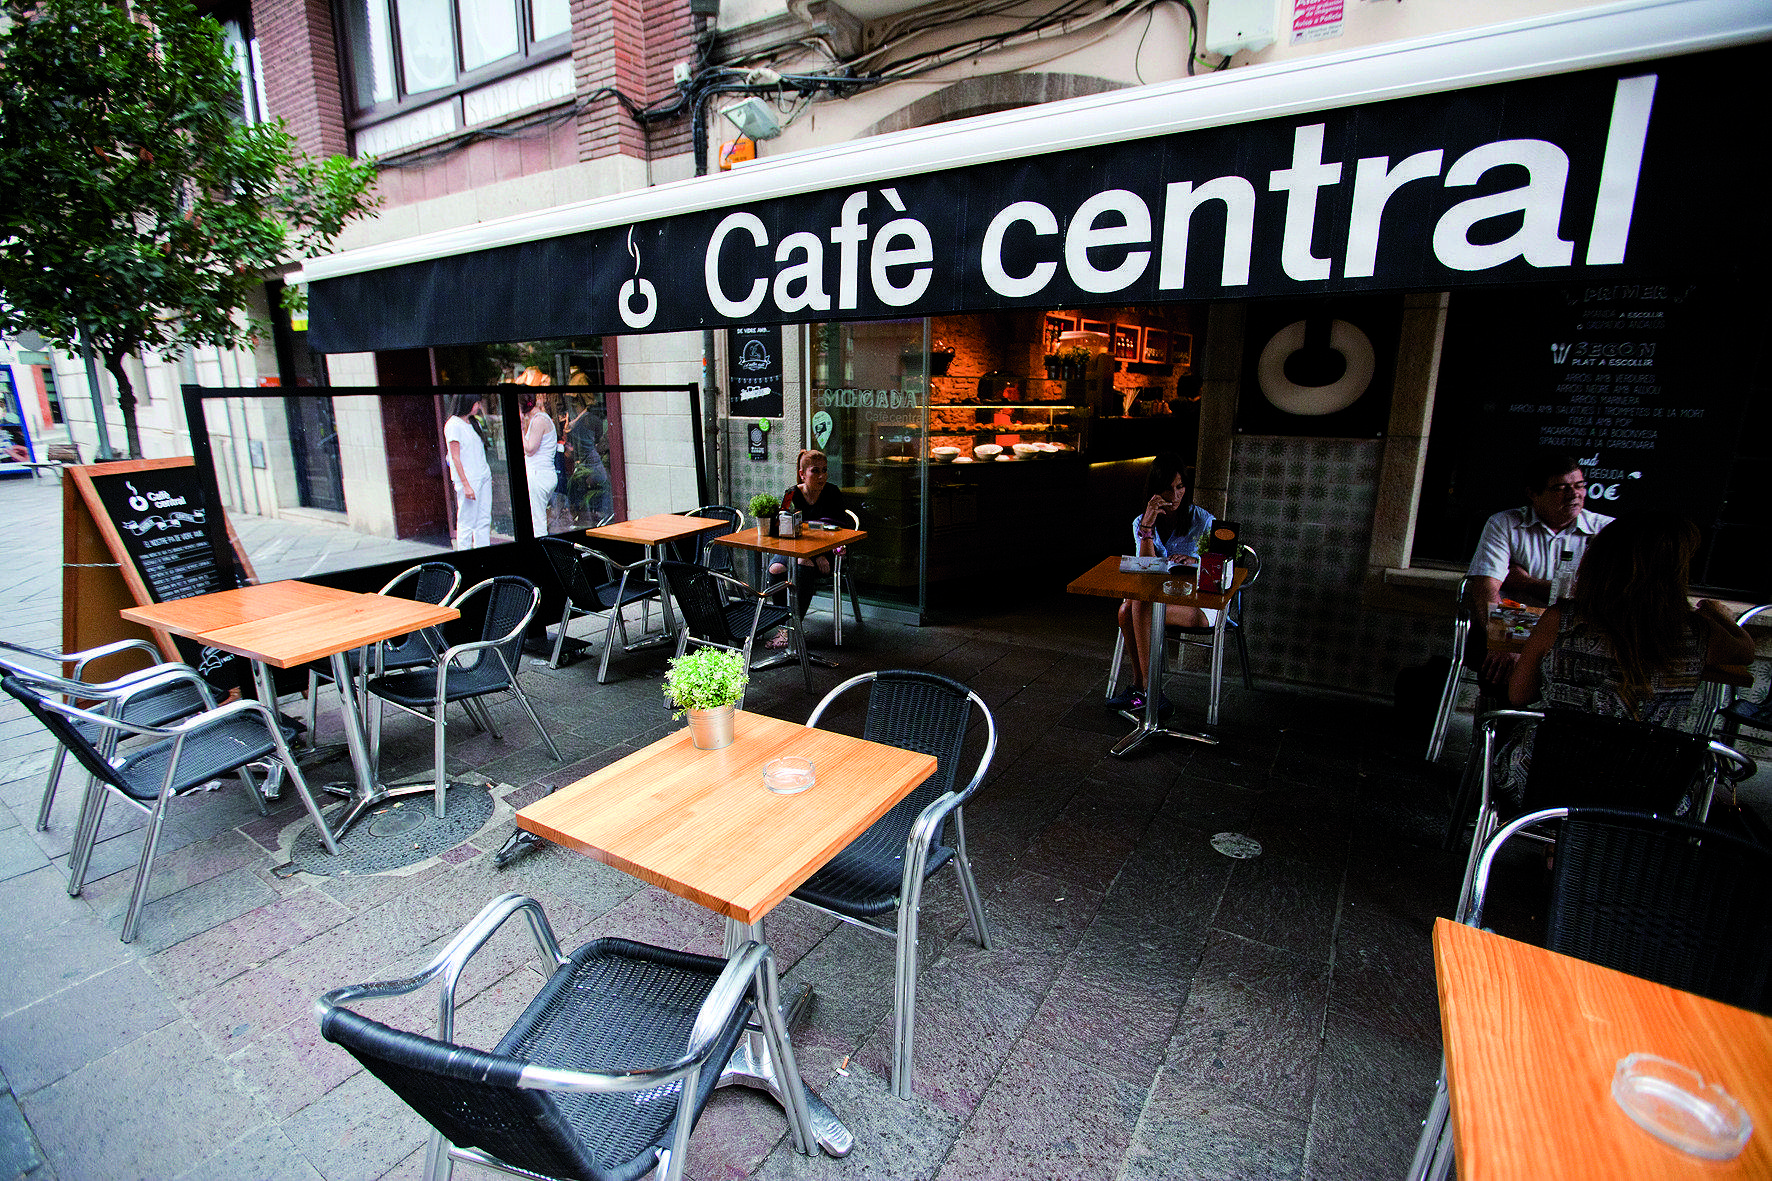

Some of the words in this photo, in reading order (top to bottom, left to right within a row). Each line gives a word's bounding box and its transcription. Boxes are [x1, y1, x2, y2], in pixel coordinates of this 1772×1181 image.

[705, 188, 934, 319] Cafè
[981, 74, 1659, 298] central
[1573, 341, 1657, 357] SEGON
[1571, 358, 1597, 366] PLAT
[1598, 358, 1607, 366] A
[1607, 358, 1654, 367] ESCOLLIR
